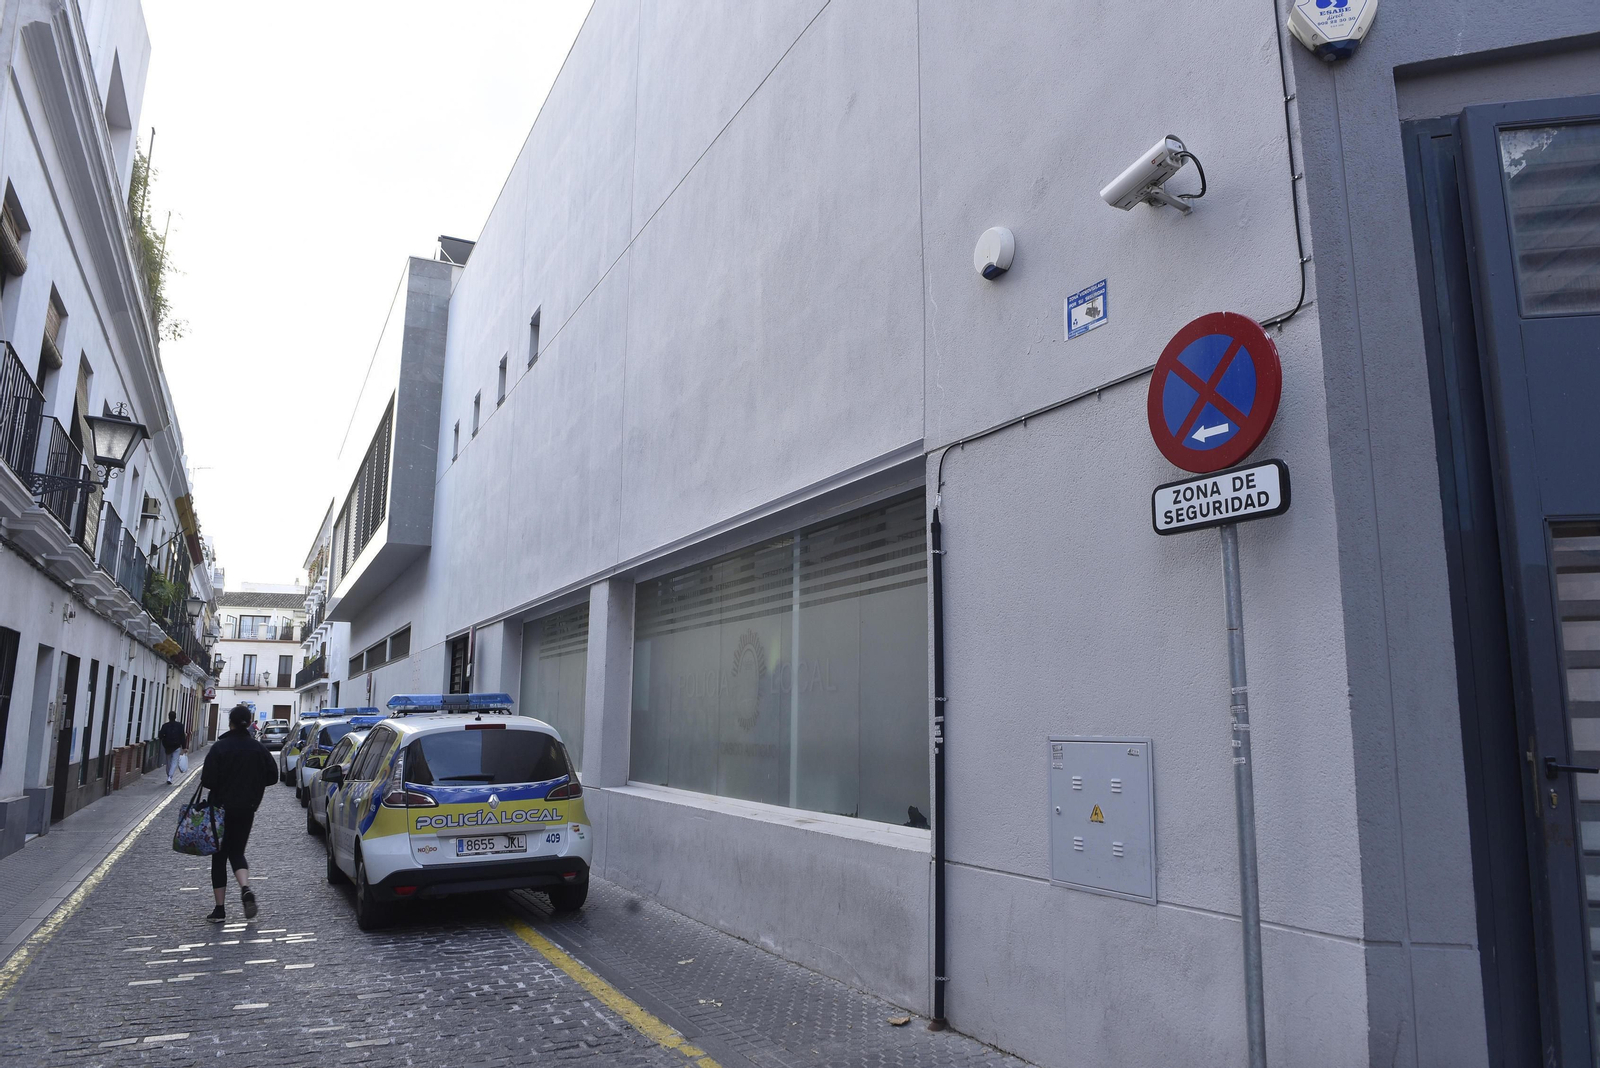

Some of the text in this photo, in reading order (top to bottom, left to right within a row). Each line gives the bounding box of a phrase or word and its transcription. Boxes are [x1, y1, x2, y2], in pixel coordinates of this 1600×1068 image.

[1319, 6, 1352, 16] ESABE
[1172, 473, 1257, 505] ZONA DE
[1163, 491, 1270, 525] SEGURIDAD
[416, 808, 564, 830] POLICÍA LOCAL
[466, 836, 525, 851] 8655 JKL
[545, 833, 561, 843] 409
